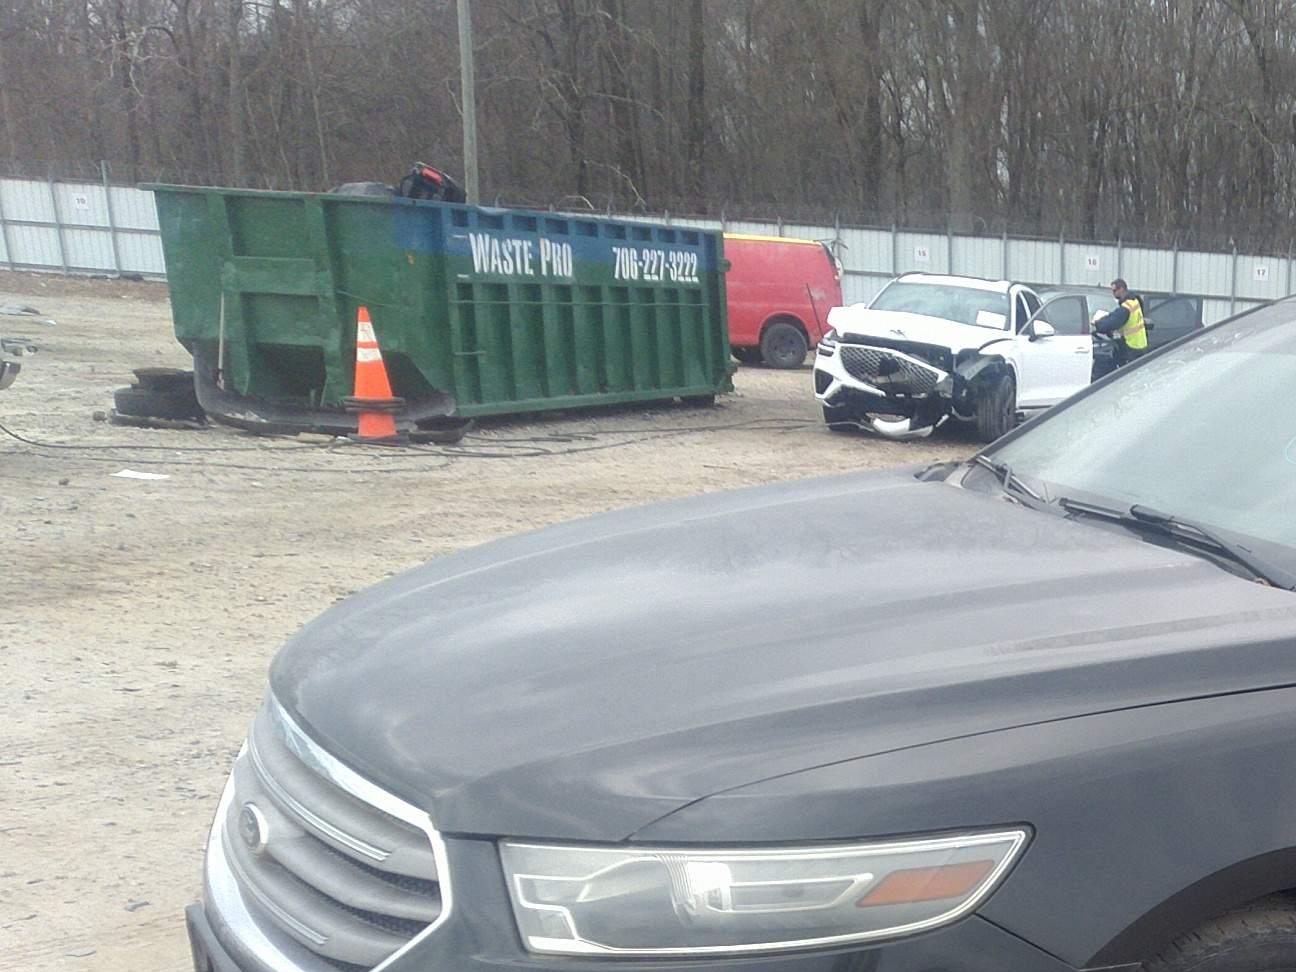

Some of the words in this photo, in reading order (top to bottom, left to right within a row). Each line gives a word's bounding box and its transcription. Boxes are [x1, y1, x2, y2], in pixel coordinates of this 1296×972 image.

[469, 232, 535, 276] WASTE
[539, 237, 574, 278] PRO
[612, 246, 700, 283] 706-227-3222
